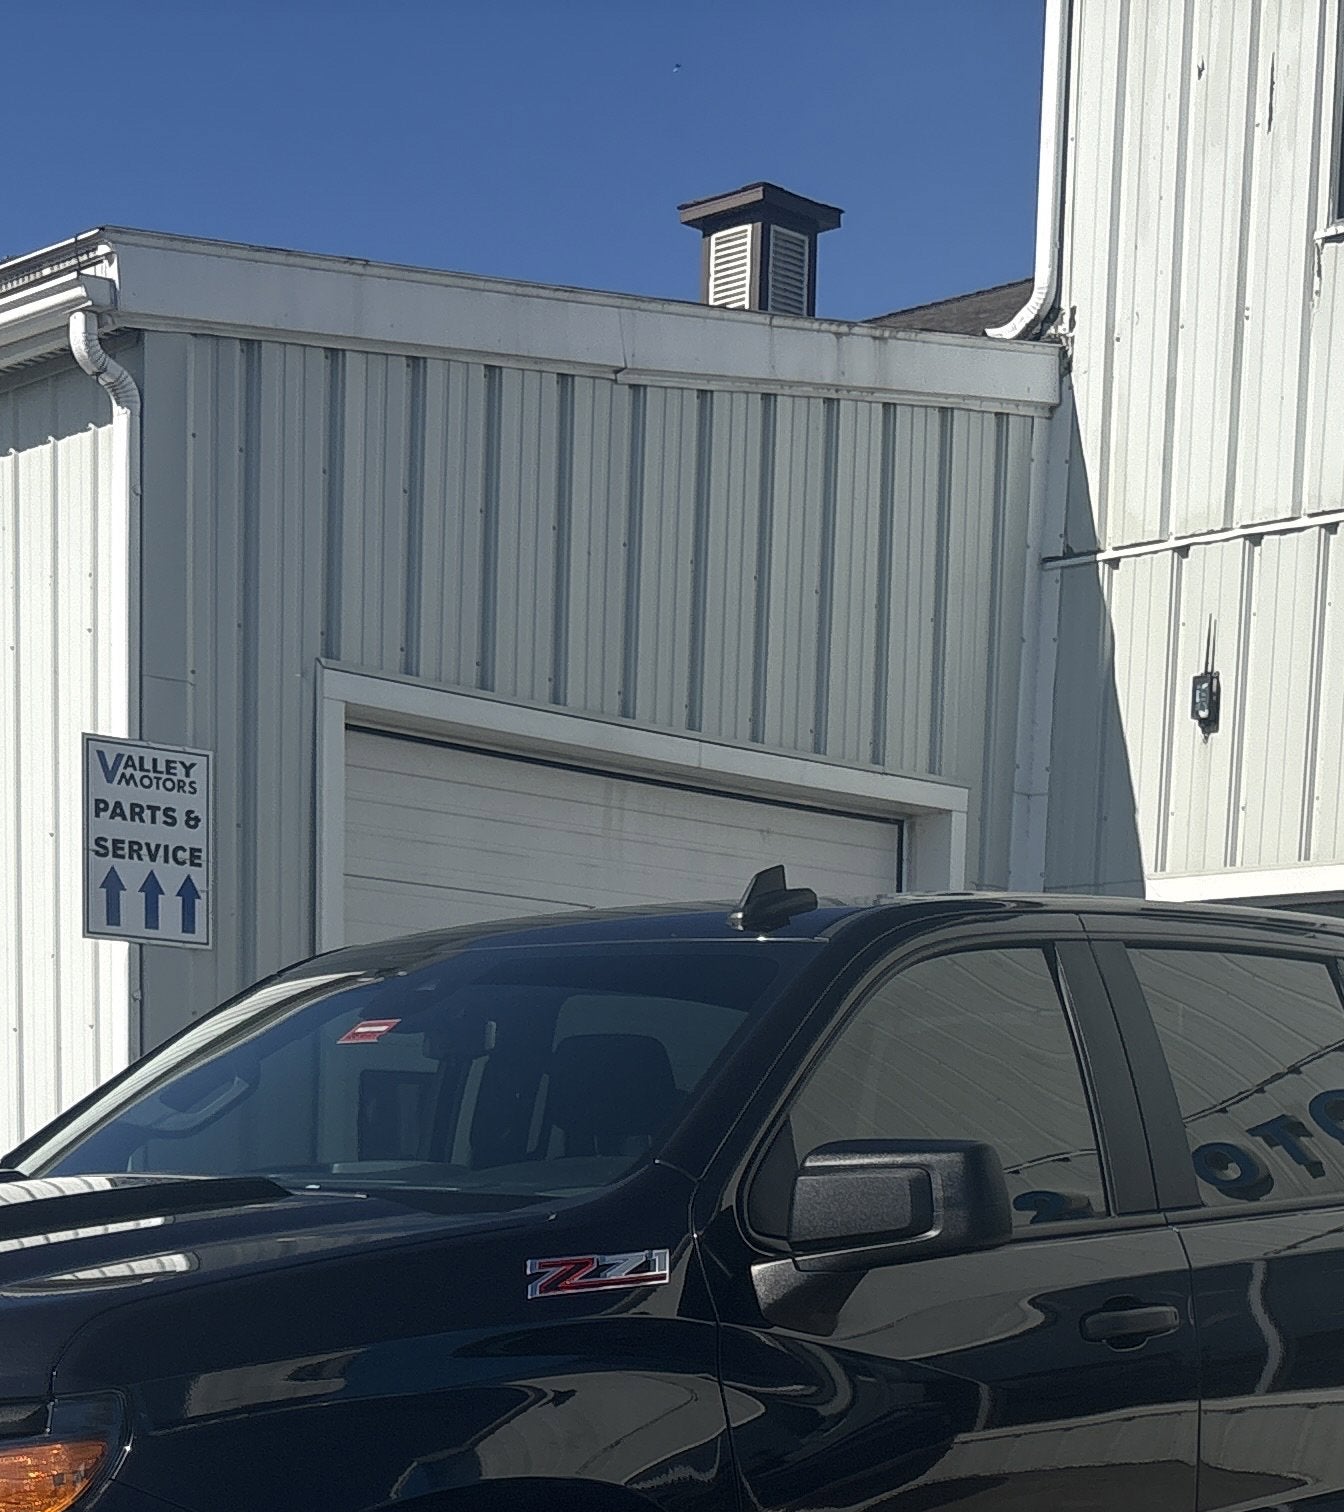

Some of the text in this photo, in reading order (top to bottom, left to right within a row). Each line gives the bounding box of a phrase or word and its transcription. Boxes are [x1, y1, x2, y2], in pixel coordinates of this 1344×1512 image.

[96, 750, 197, 784] VALLEY
[117, 774, 197, 795] MOTORS
[94, 798, 202, 829] PARTS &
[94, 836, 203, 868] SERVICE
[526, 1249, 669, 1299] Z71
